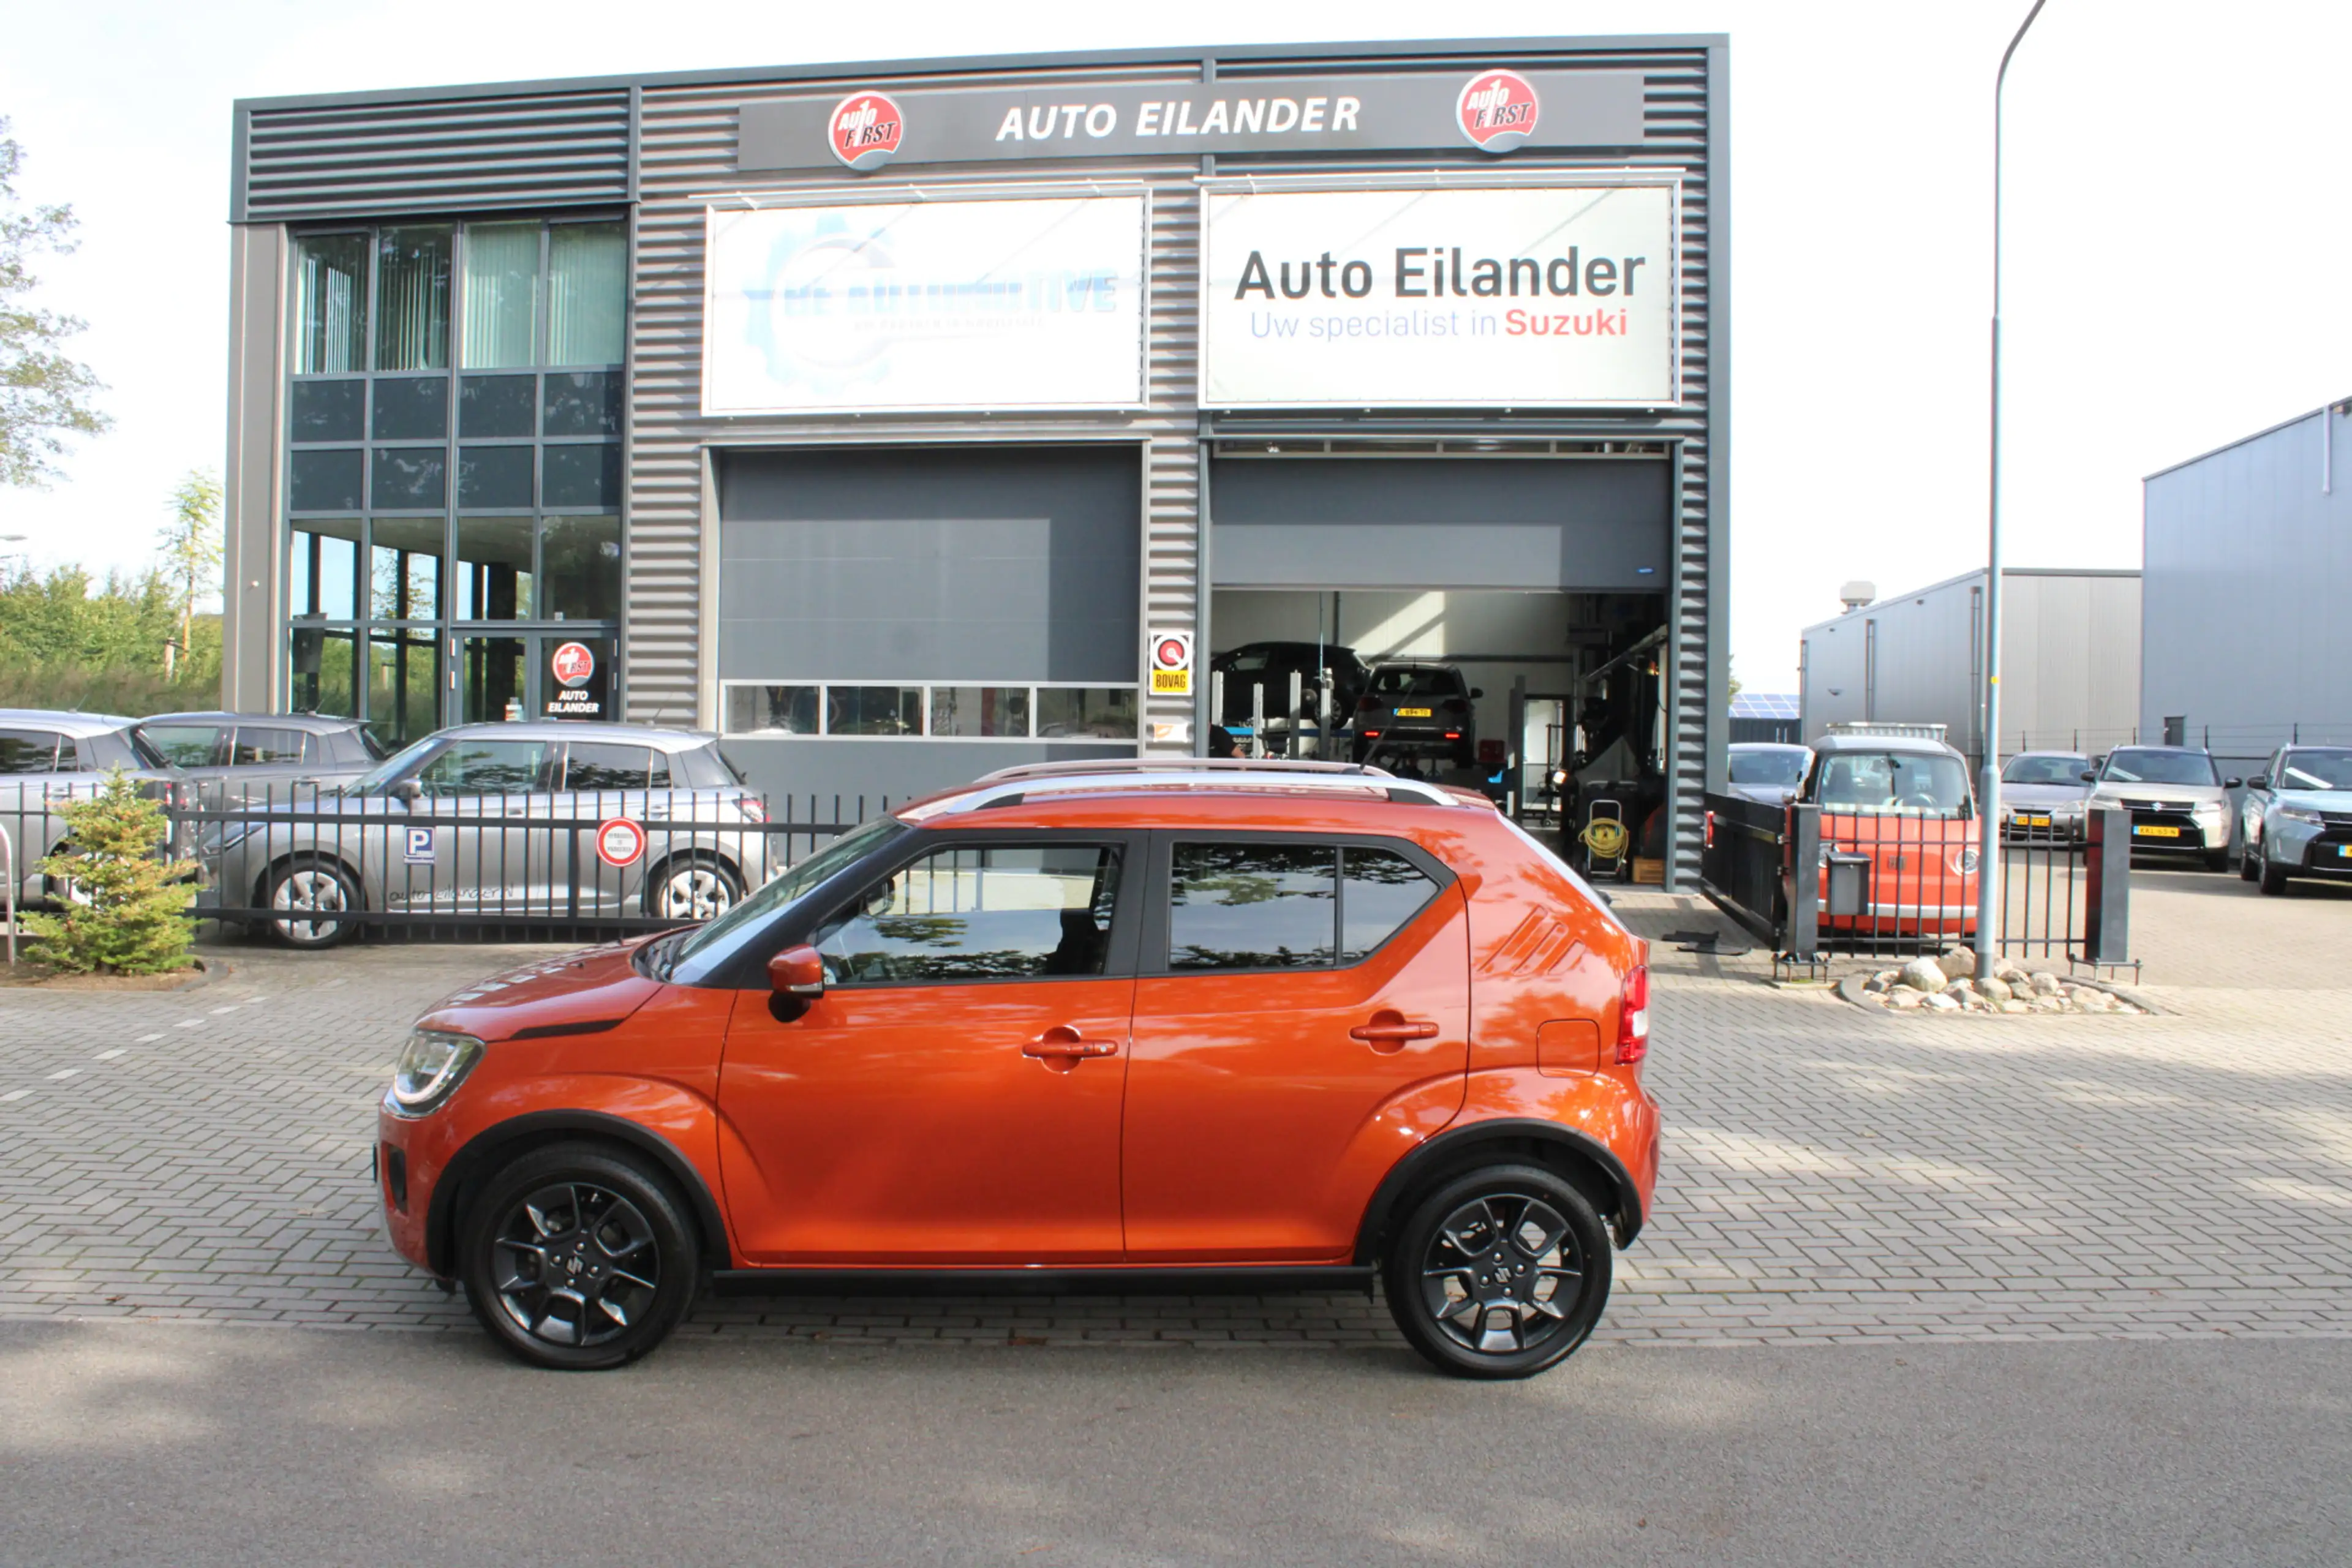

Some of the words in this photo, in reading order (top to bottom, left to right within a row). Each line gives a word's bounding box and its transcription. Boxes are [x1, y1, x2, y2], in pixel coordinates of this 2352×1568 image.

[995, 104, 1117, 141] AUTO
[1136, 96, 1361, 137] EILANDER
[1234, 250, 1373, 300] Auto
[1395, 246, 1646, 298] Eilander
[1251, 311, 1299, 339] Uw
[1309, 308, 1460, 342] specialist
[1471, 309, 1496, 337] in
[1505, 308, 1628, 336] Suzuki
[1156, 673, 1186, 688] BOVAG
[558, 690, 589, 701] AUTO
[548, 703, 600, 713] EILANDER
[409, 830, 429, 854] P
